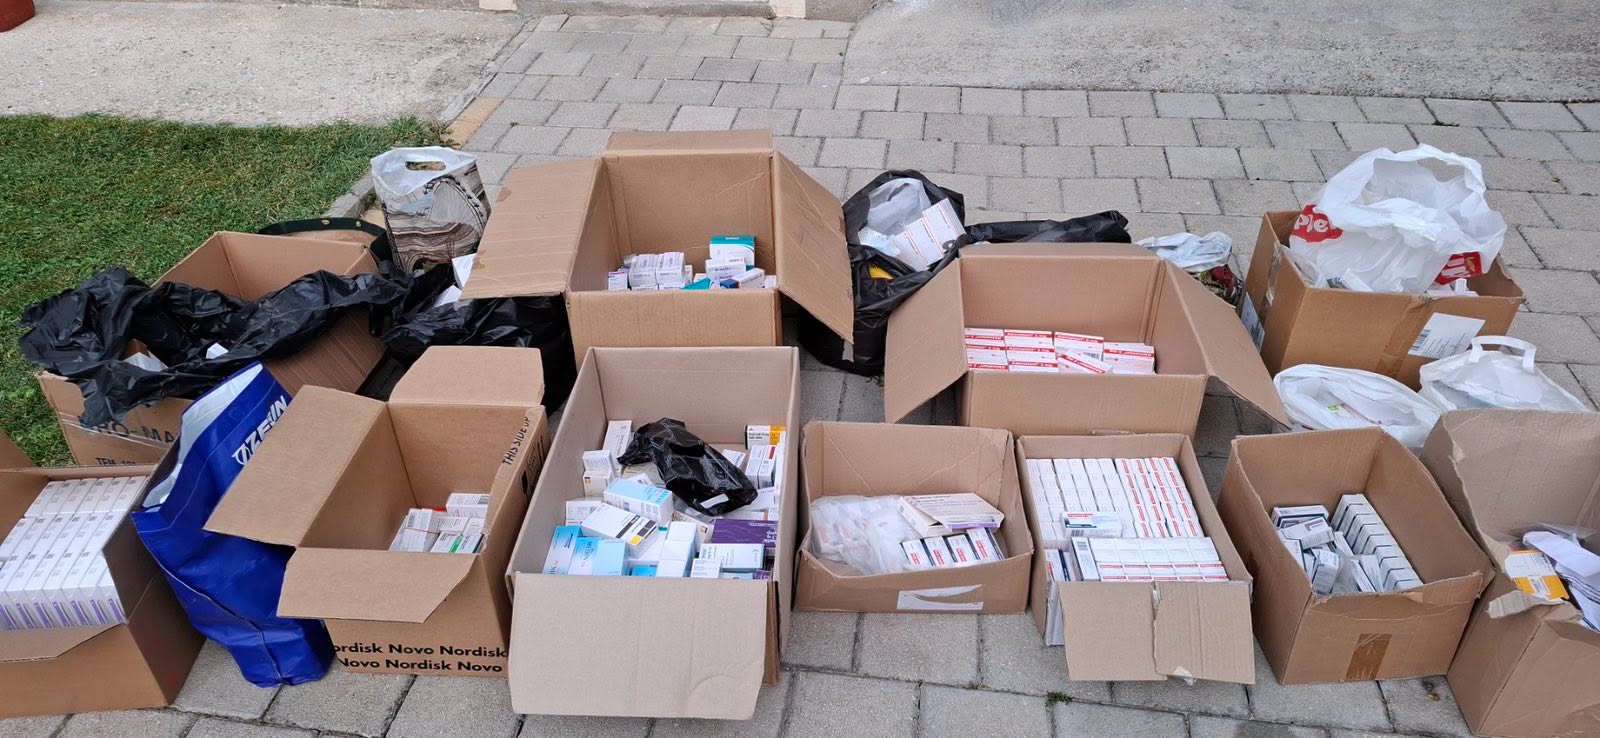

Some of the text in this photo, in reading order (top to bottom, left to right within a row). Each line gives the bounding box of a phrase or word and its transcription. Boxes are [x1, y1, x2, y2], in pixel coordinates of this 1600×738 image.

[502, 447, 518, 465] THIS
[513, 428, 527, 446] SIDE
[388, 643, 435, 655] Novo
[439, 645, 508, 658] Nordisk
[338, 657, 503, 673] Novo Nordisk Novo
